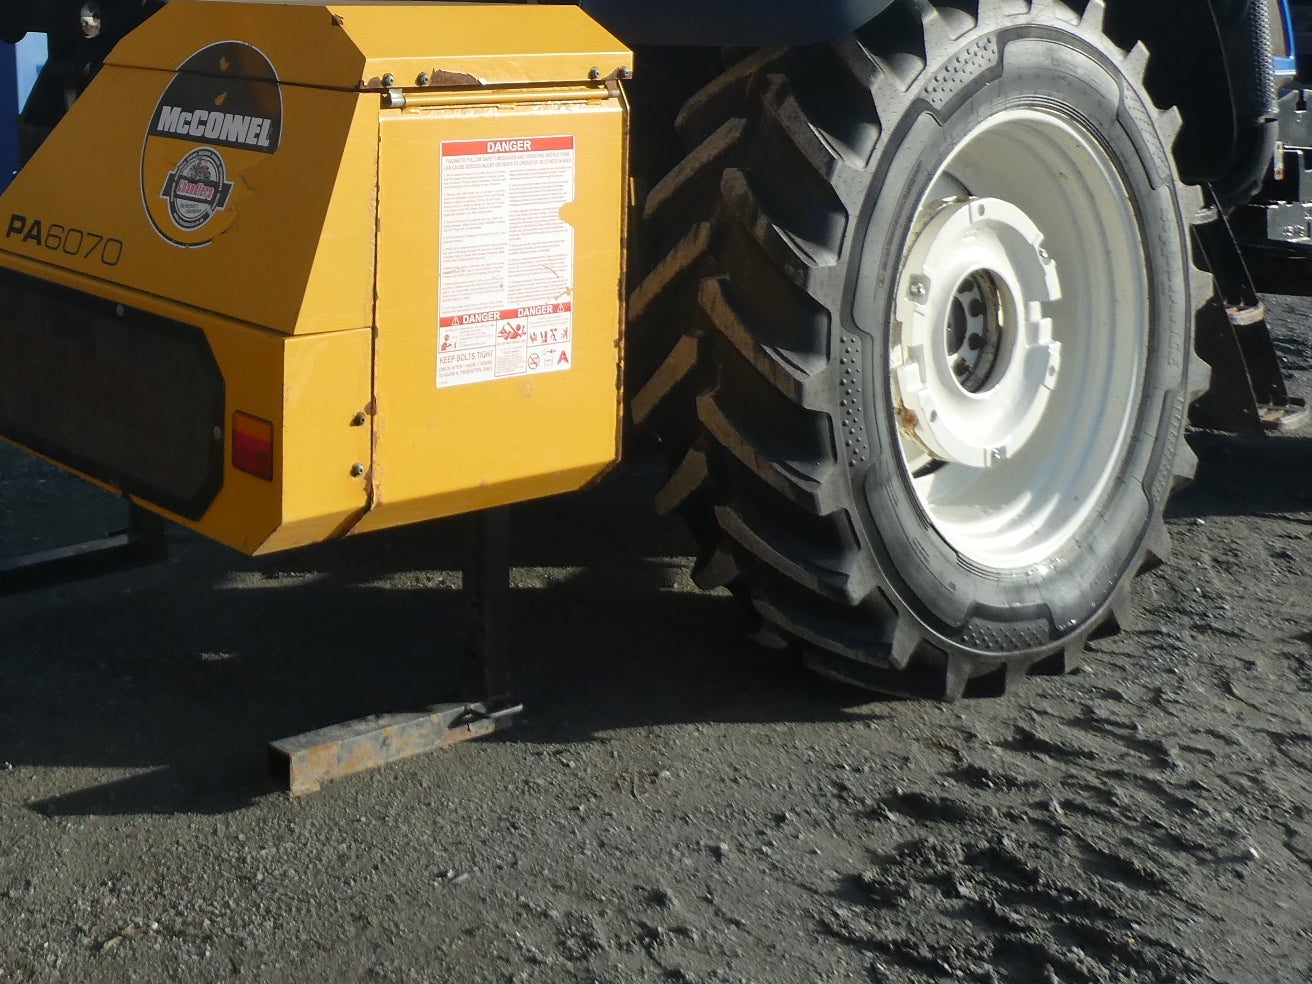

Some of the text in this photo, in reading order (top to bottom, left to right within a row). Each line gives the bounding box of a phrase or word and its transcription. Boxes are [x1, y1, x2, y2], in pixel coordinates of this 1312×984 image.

[157, 105, 272, 147] McCONNEL
[487, 140, 532, 153] DANGER
[5, 214, 123, 266] PA6070
[462, 304, 554, 324] DANGER DANGER
[439, 350, 494, 365] KEEP BOLTS TIGHT
